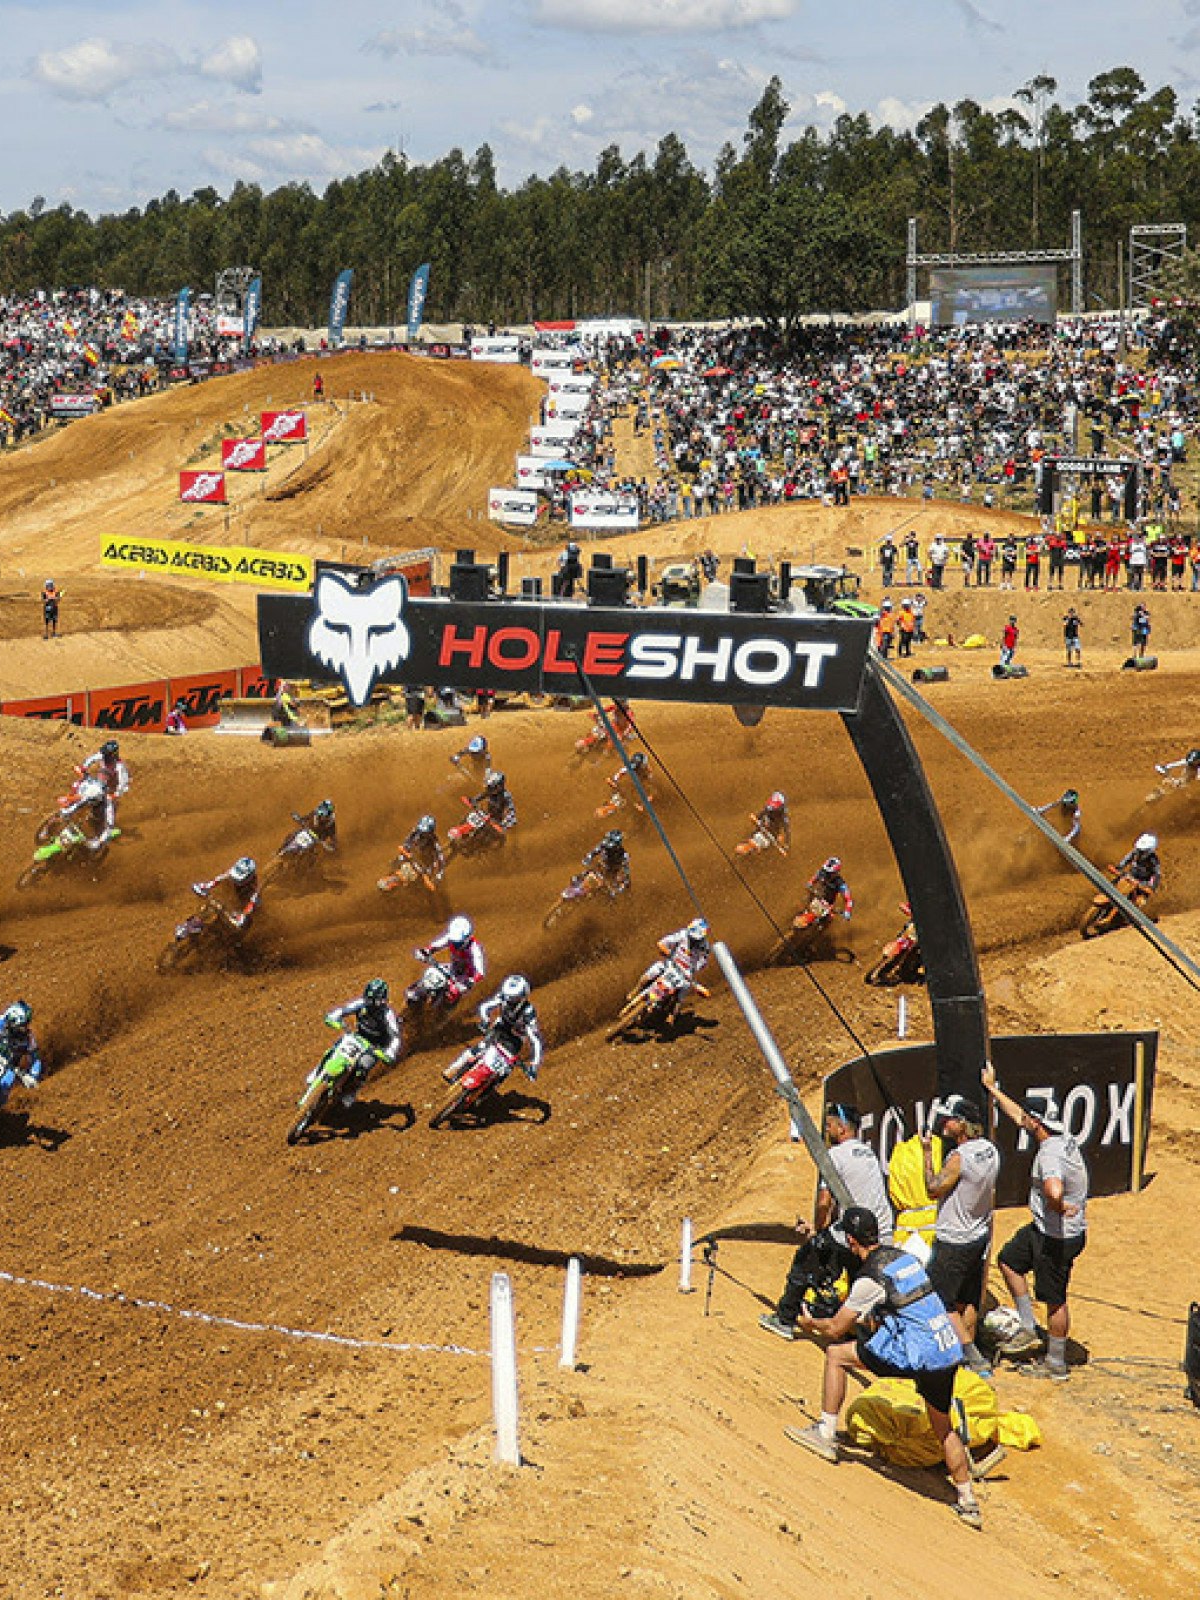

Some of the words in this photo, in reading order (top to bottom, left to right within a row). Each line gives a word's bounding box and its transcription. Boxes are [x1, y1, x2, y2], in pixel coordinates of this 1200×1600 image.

[103, 543, 169, 566] ACERBIS
[170, 551, 232, 574] ACERBIS
[234, 556, 308, 582] ACERBIS
[438, 624, 839, 687] HOLESHOT
[94, 696, 163, 729] KTM
